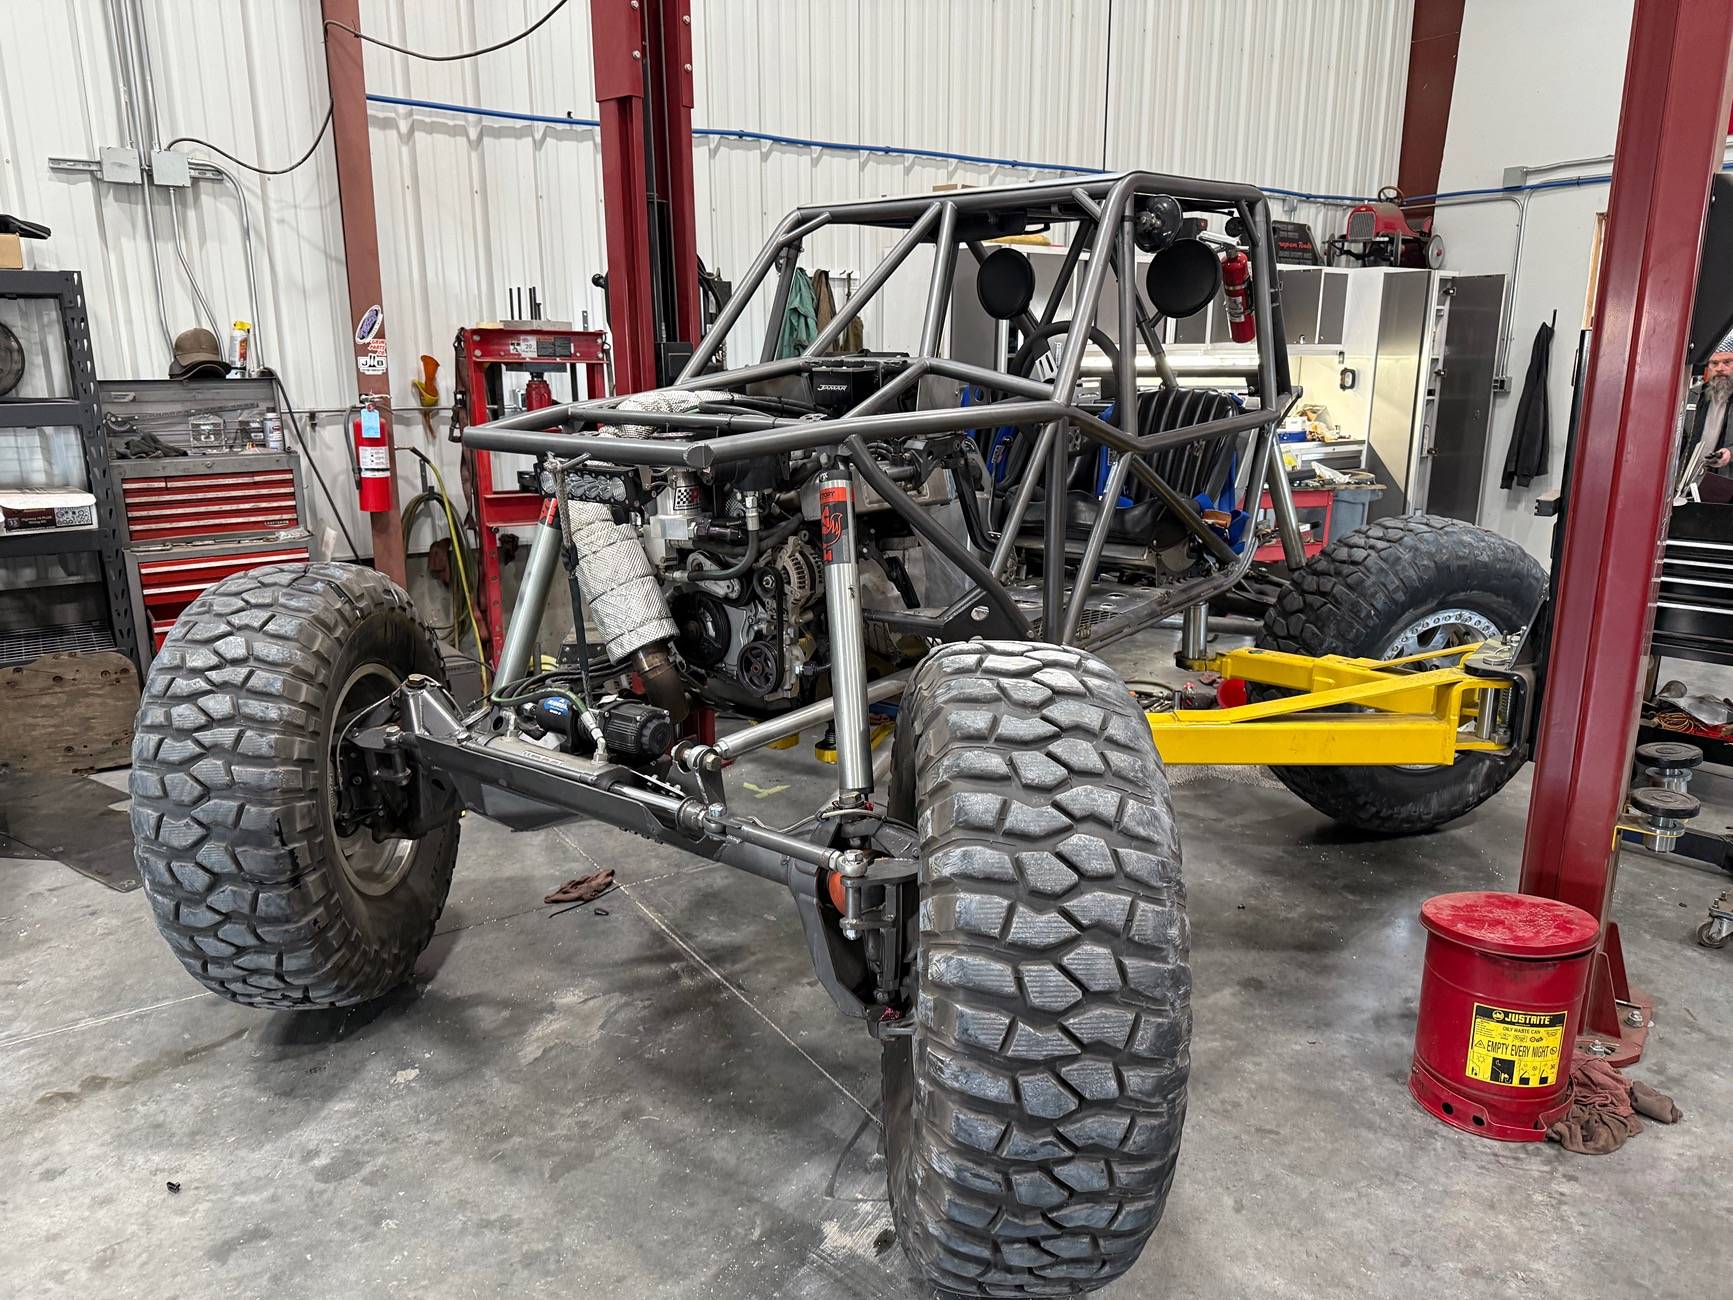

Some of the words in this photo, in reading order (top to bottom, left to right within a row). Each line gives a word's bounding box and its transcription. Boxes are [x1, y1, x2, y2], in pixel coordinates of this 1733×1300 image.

[1504, 1012, 1551, 1025] JUSTRITE
[1486, 1040, 1510, 1056] EMPTY
[1510, 1044, 1532, 1058] EVERY
[1532, 1045, 1550, 1059] NIGHT
